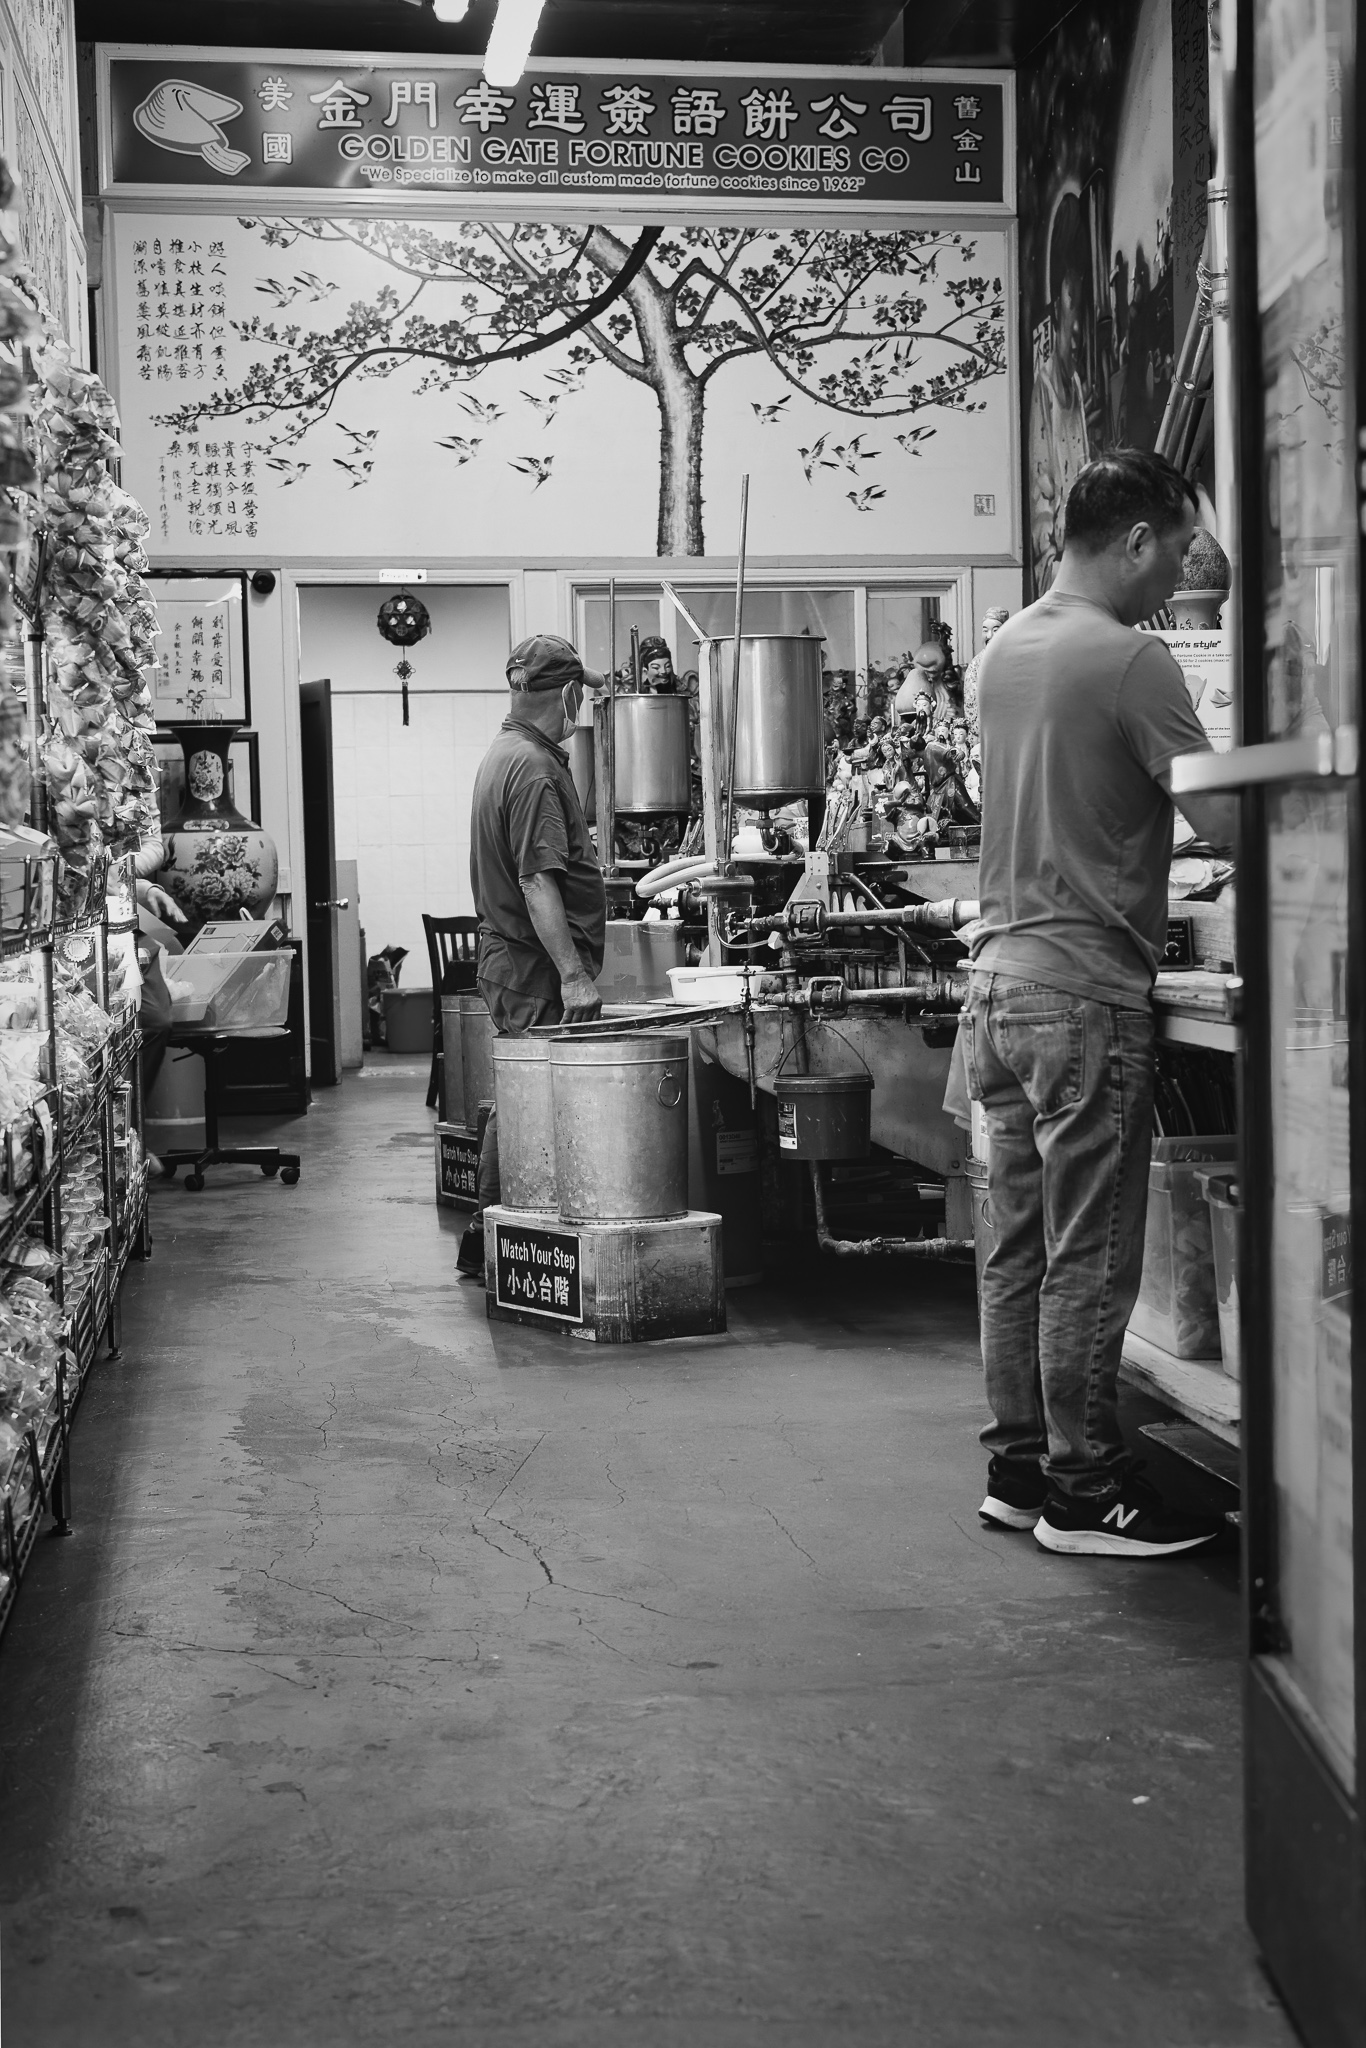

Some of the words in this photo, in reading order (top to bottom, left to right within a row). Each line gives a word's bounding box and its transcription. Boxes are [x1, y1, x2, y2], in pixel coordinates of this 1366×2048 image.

[258, 76, 293, 165] 美國
[953, 96, 983, 183] 舊金山
[338, 134, 471, 163] GOLDEN
[481, 138, 558, 164] GATE
[569, 140, 703, 168] FORTUNE
[713, 143, 850, 172] COOKIES
[859, 146, 910, 173] CO
[395, 167, 471, 184] Specialize
[474, 169, 490, 183] to
[493, 170, 535, 184] make
[538, 171, 558, 185] all
[561, 172, 616, 187] custom
[618, 173, 665, 188] made
[666, 174, 719, 190] fortune
[722, 175, 778, 190] cookies
[779, 177, 819, 192] since
[1166, 640, 1191, 648] evin's
[445, 1165, 476, 1193] 小心台階
[500, 1237, 529, 1262] Watch
[530, 1242, 553, 1266] Your
[553, 1246, 576, 1275] Step
[506, 1267, 570, 1306] 小心台階
[1102, 1503, 1139, 1529] N
